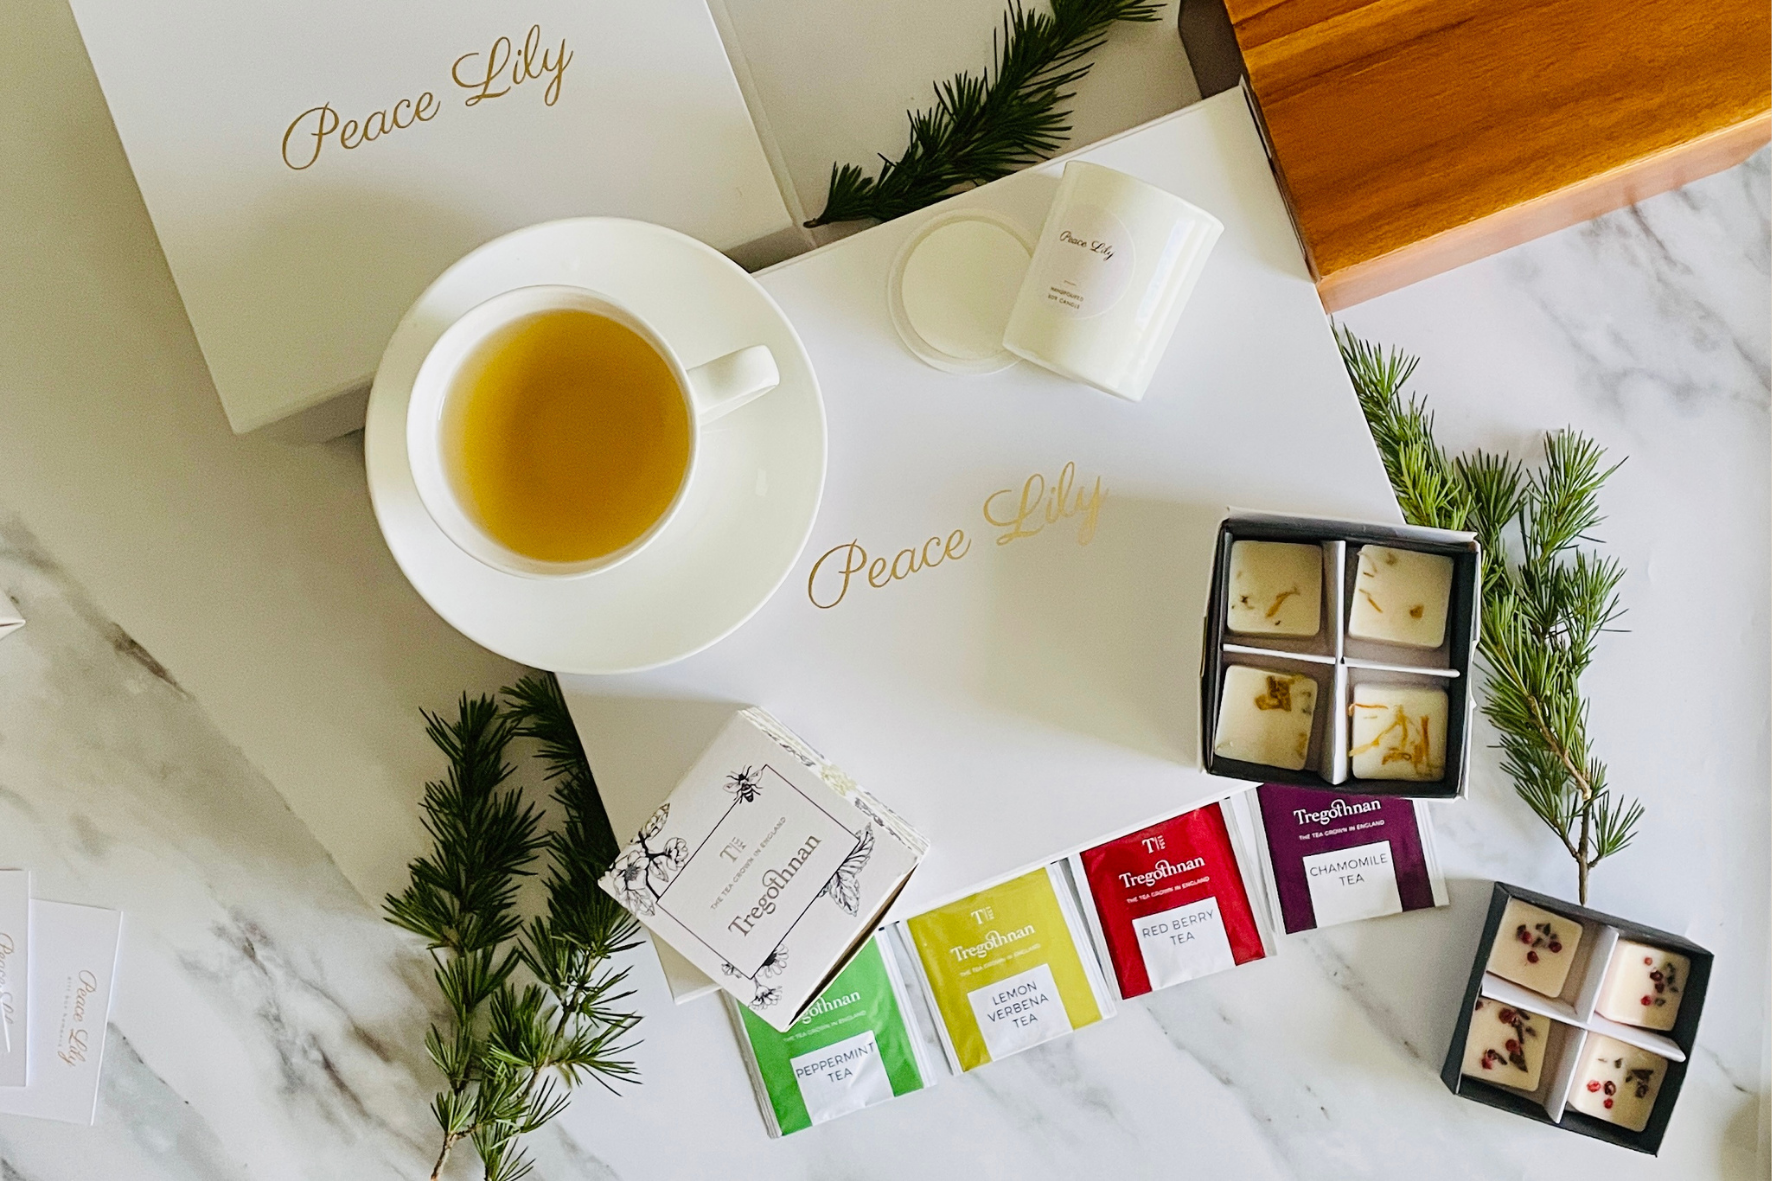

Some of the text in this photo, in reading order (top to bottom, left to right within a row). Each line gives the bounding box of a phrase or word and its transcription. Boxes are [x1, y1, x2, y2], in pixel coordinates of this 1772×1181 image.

[281, 25, 573, 169] Peace Lily
[1060, 231, 1115, 260] Peace Lily
[807, 462, 1108, 608] Peace Lily
[1293, 799, 1381, 824] Tregothnan
[710, 897, 722, 909] THE
[721, 883, 733, 895] TEA
[753, 848, 761, 856] IN
[760, 817, 785, 847] ENGLAND
[1118, 857, 1205, 887] Tregothnan
[1309, 853, 1387, 876] CHAMOMILE
[727, 836, 821, 936] Tregothnan
[1339, 874, 1364, 886] TEA
[1142, 910, 1213, 937] RED BERRY
[950, 925, 1035, 962] Tregothnan
[1170, 932, 1195, 945] TEA
[74, 971, 96, 1021] Peace
[992, 981, 1037, 1005] LEMON
[987, 994, 1049, 1022] VERBENA
[1012, 1016, 1038, 1028] TEA
[57, 1029, 87, 1066] Lily
[795, 1042, 874, 1078] PEPPERMINT
[827, 1069, 852, 1082] TEA
